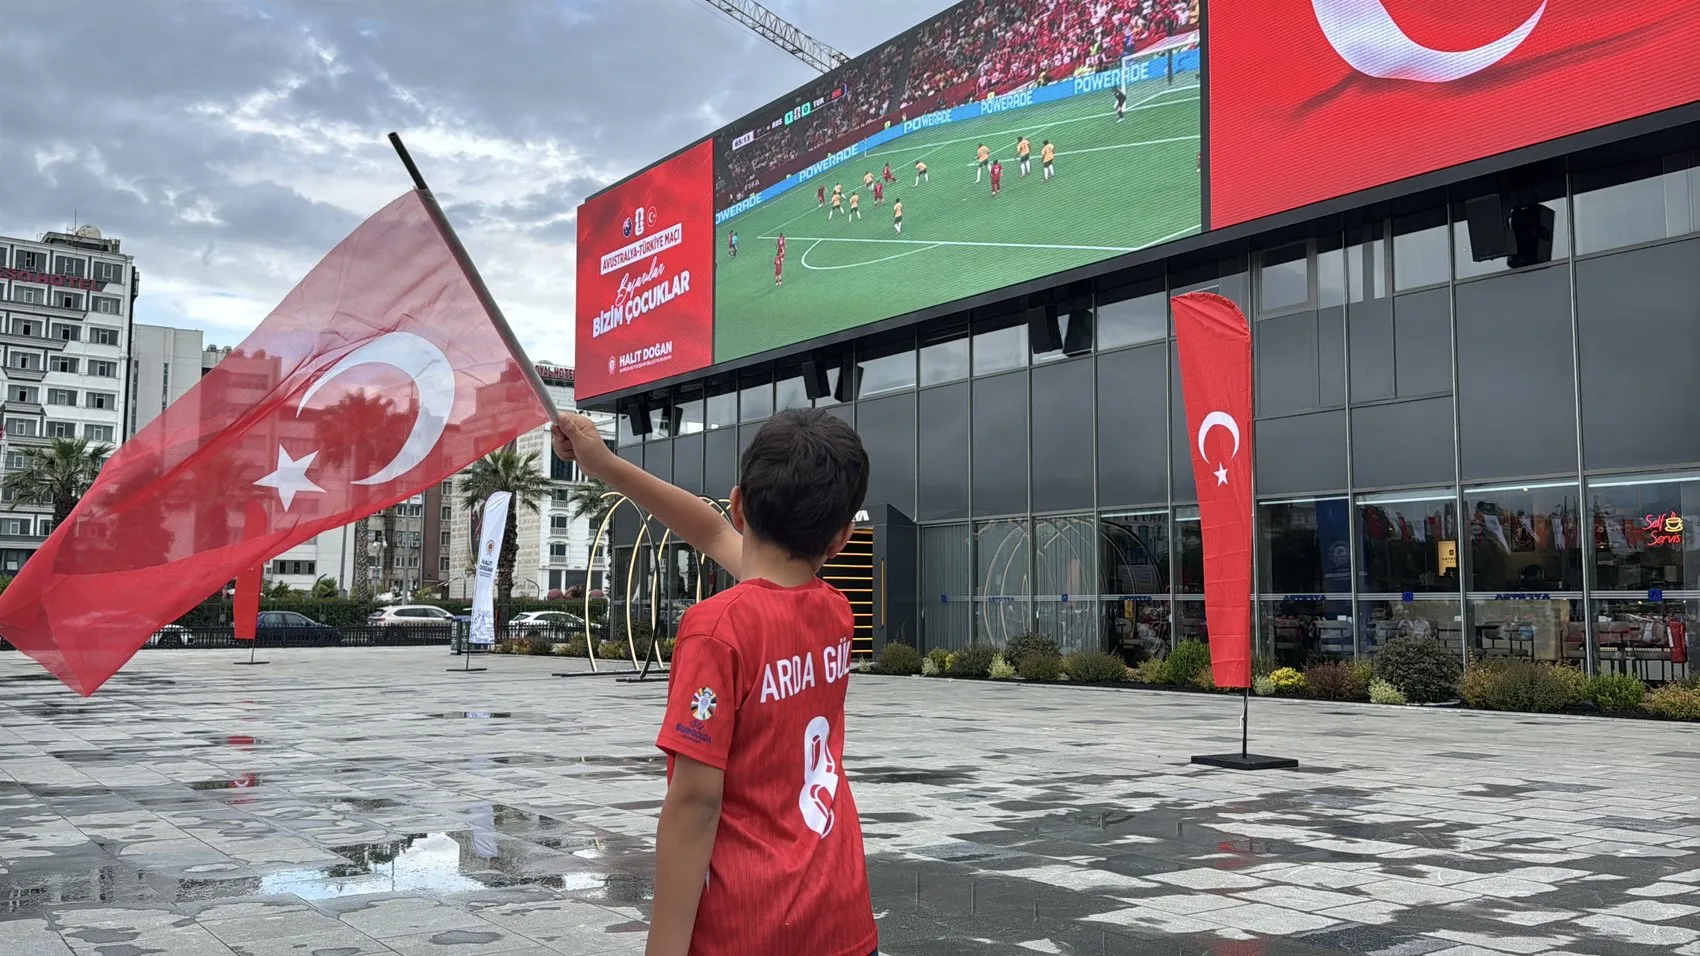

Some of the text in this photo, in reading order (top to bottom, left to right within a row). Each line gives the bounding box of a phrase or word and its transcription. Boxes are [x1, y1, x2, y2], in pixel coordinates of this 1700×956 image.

[1074, 61, 1149, 94] POWERADE
[981, 91, 1032, 114] POWERADE
[903, 109, 952, 133] POWERADE
[800, 143, 859, 182] POWERADE
[744, 180, 760, 192] FIFA
[665, 228, 681, 245] MAÇI
[36, 274, 100, 292] HOTEL
[592, 270, 690, 339] BİZİM ÇOCUKLAR
[643, 340, 673, 360] DOĞAN
[1642, 513, 1667, 532] Self
[1648, 530, 1681, 546] Servis
[760, 651, 816, 703] ARDA
[799, 715, 839, 840] 8
